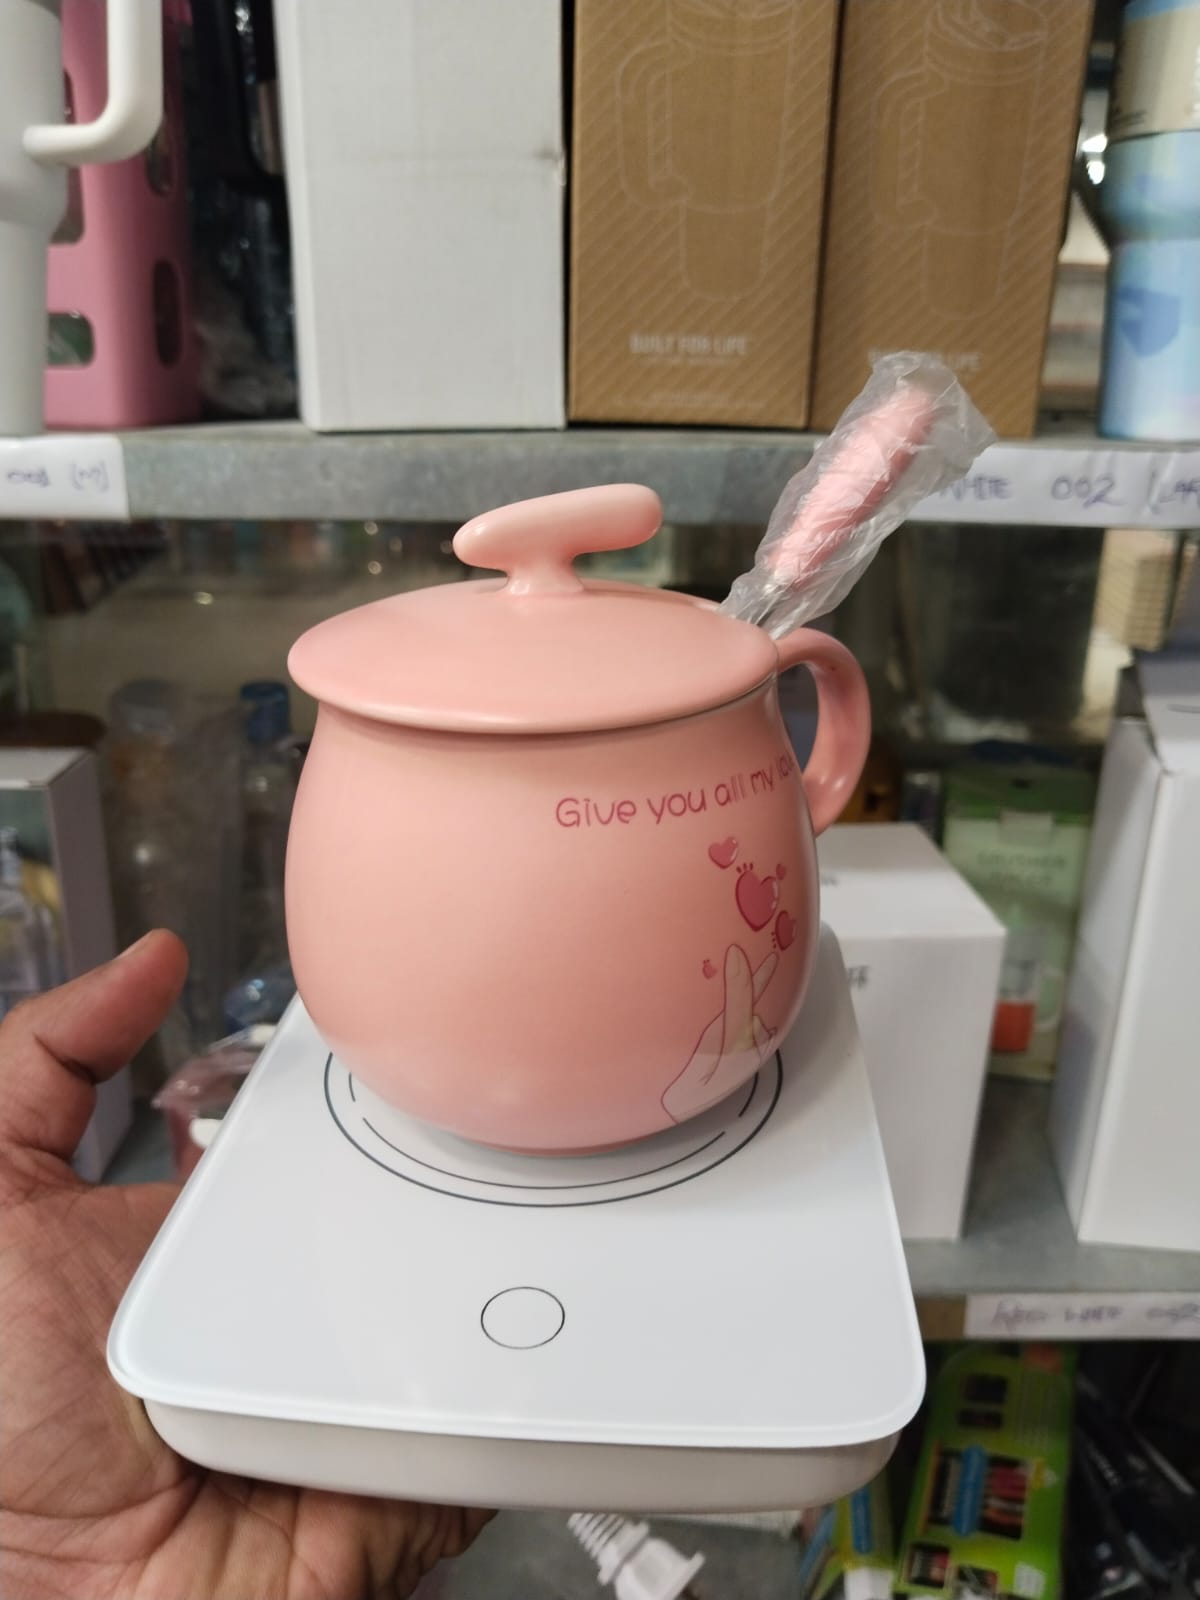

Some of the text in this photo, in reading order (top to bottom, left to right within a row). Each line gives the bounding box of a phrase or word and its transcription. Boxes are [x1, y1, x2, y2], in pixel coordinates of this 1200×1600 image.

[713, 335, 747, 356] LIFE
[555, 798, 637, 828] Give
[646, 789, 706, 825] you
[713, 772, 746, 807] all
[749, 763, 775, 796] my
